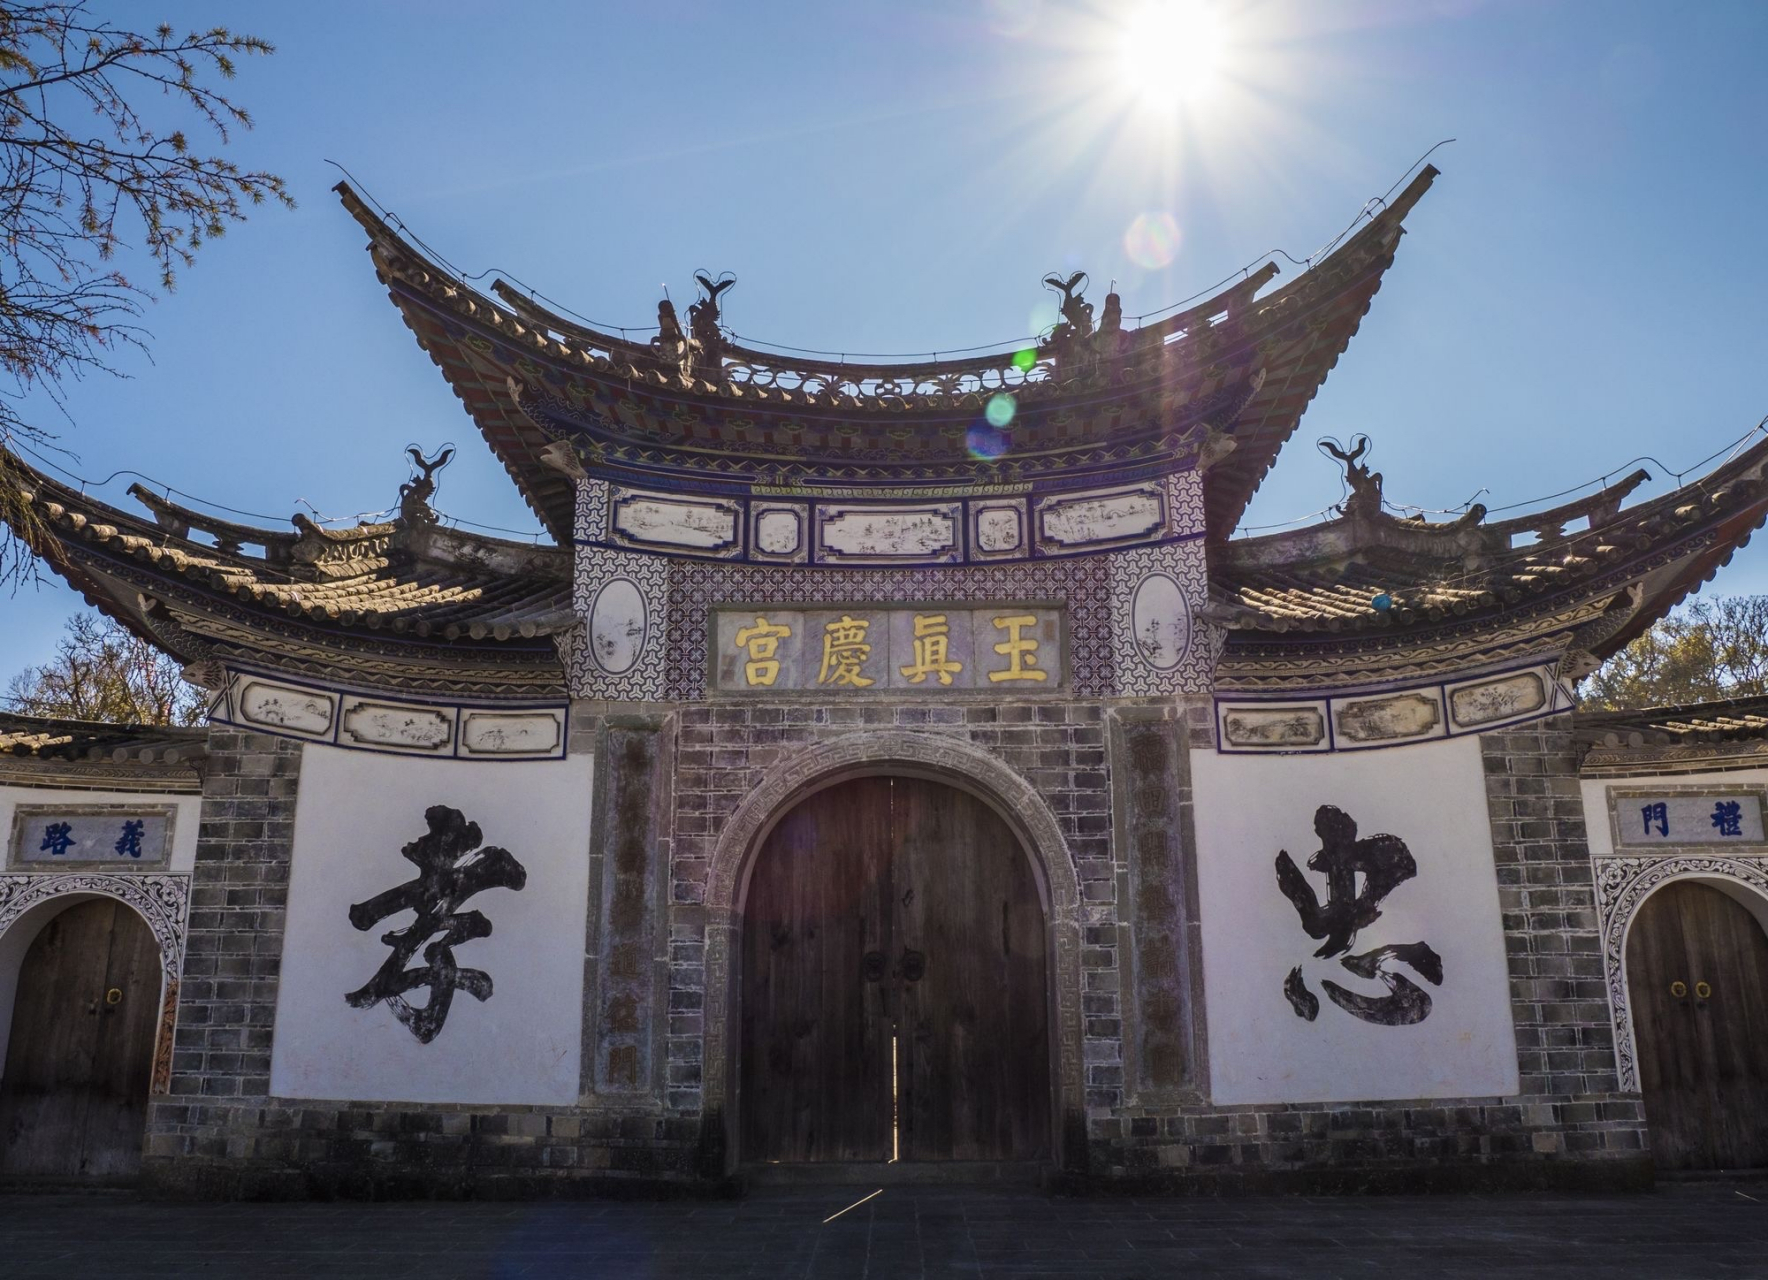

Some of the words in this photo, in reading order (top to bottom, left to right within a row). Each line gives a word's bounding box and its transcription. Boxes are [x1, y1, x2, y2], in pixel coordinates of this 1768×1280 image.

[40, 819, 145, 859] 義路
[1641, 800, 1742, 837] 禮門
[344, 805, 527, 1044] 孝
[1275, 805, 1443, 1026] 忠
